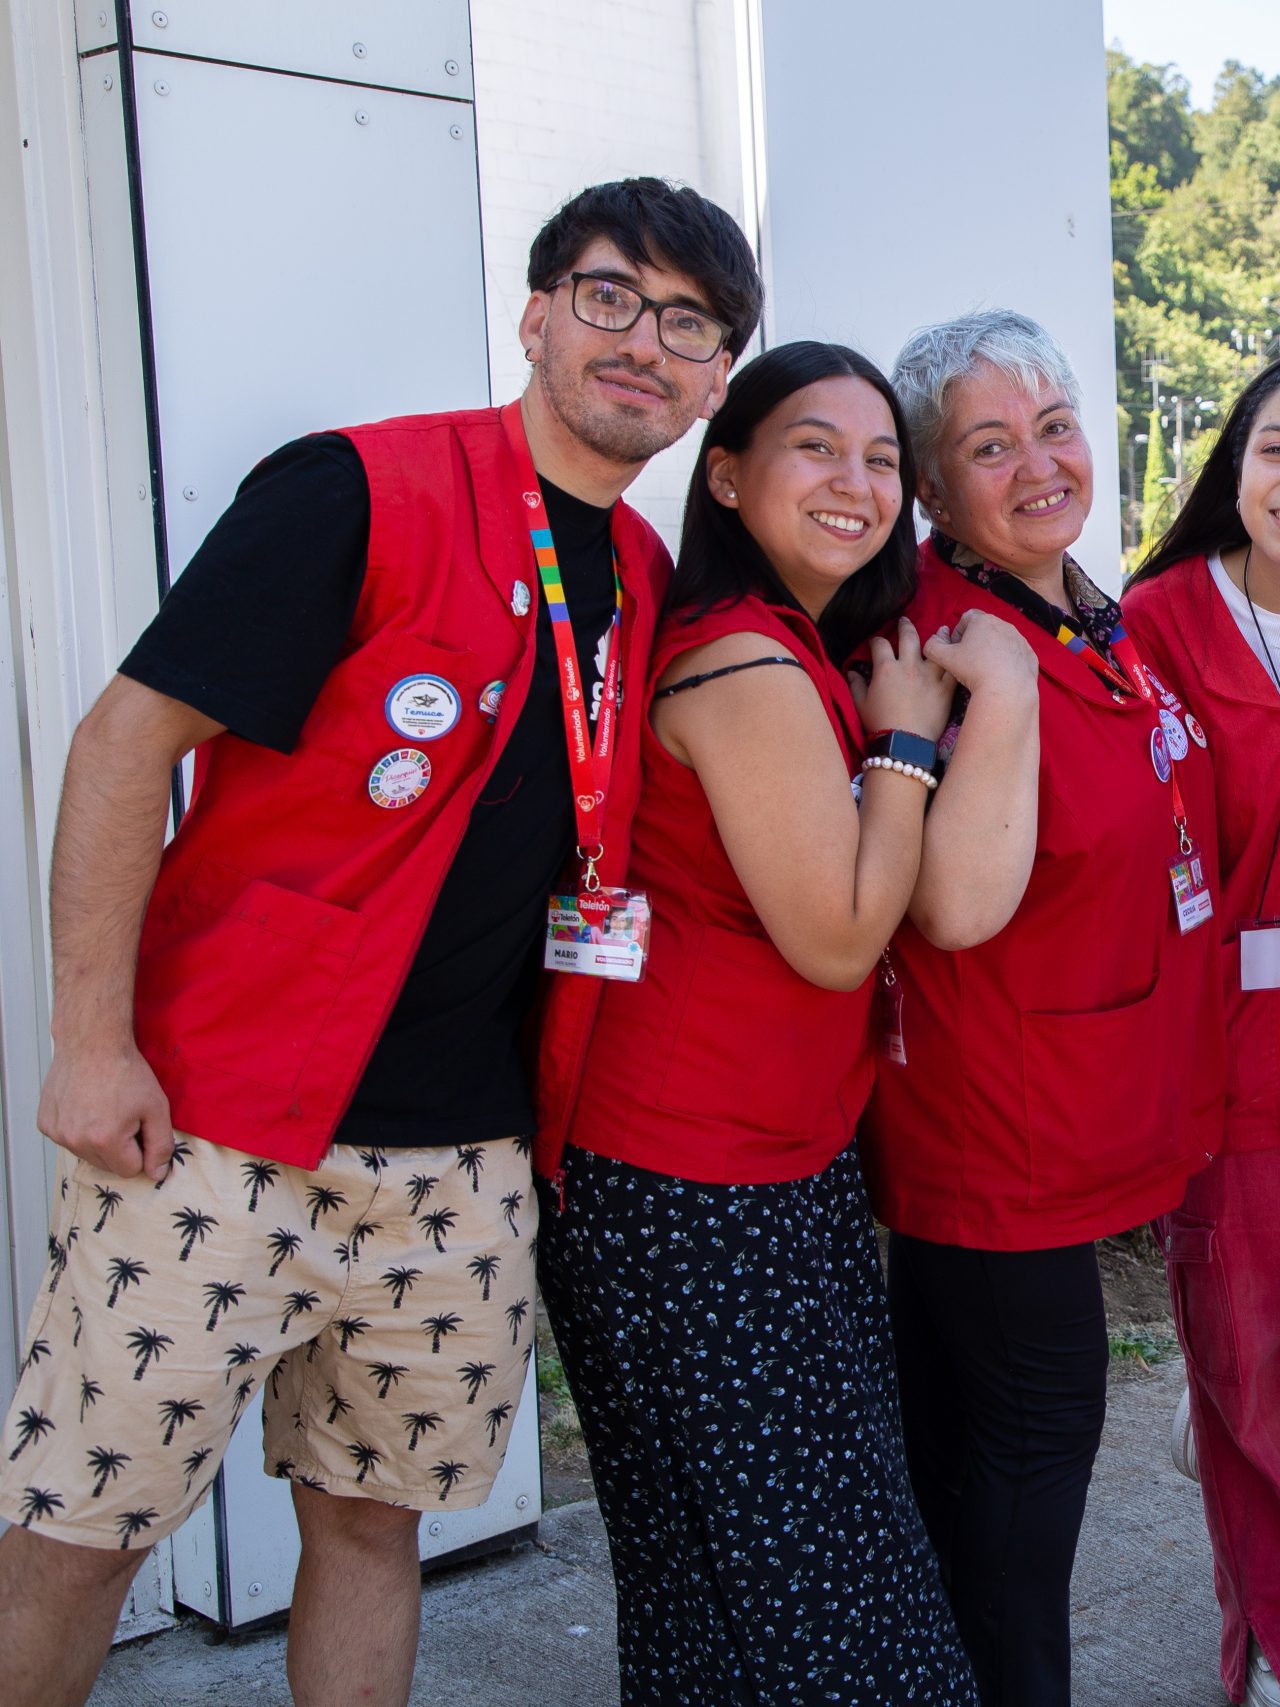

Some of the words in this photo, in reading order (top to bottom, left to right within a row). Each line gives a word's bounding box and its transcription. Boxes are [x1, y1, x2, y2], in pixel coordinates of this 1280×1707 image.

[565, 657, 576, 687] Teletón
[572, 709, 586, 763] Voluntariado
[599, 708, 611, 757] Voluntariado
[579, 899, 610, 912] Teletón
[560, 913, 580, 922] Teletón
[554, 949, 578, 960] MARIO
